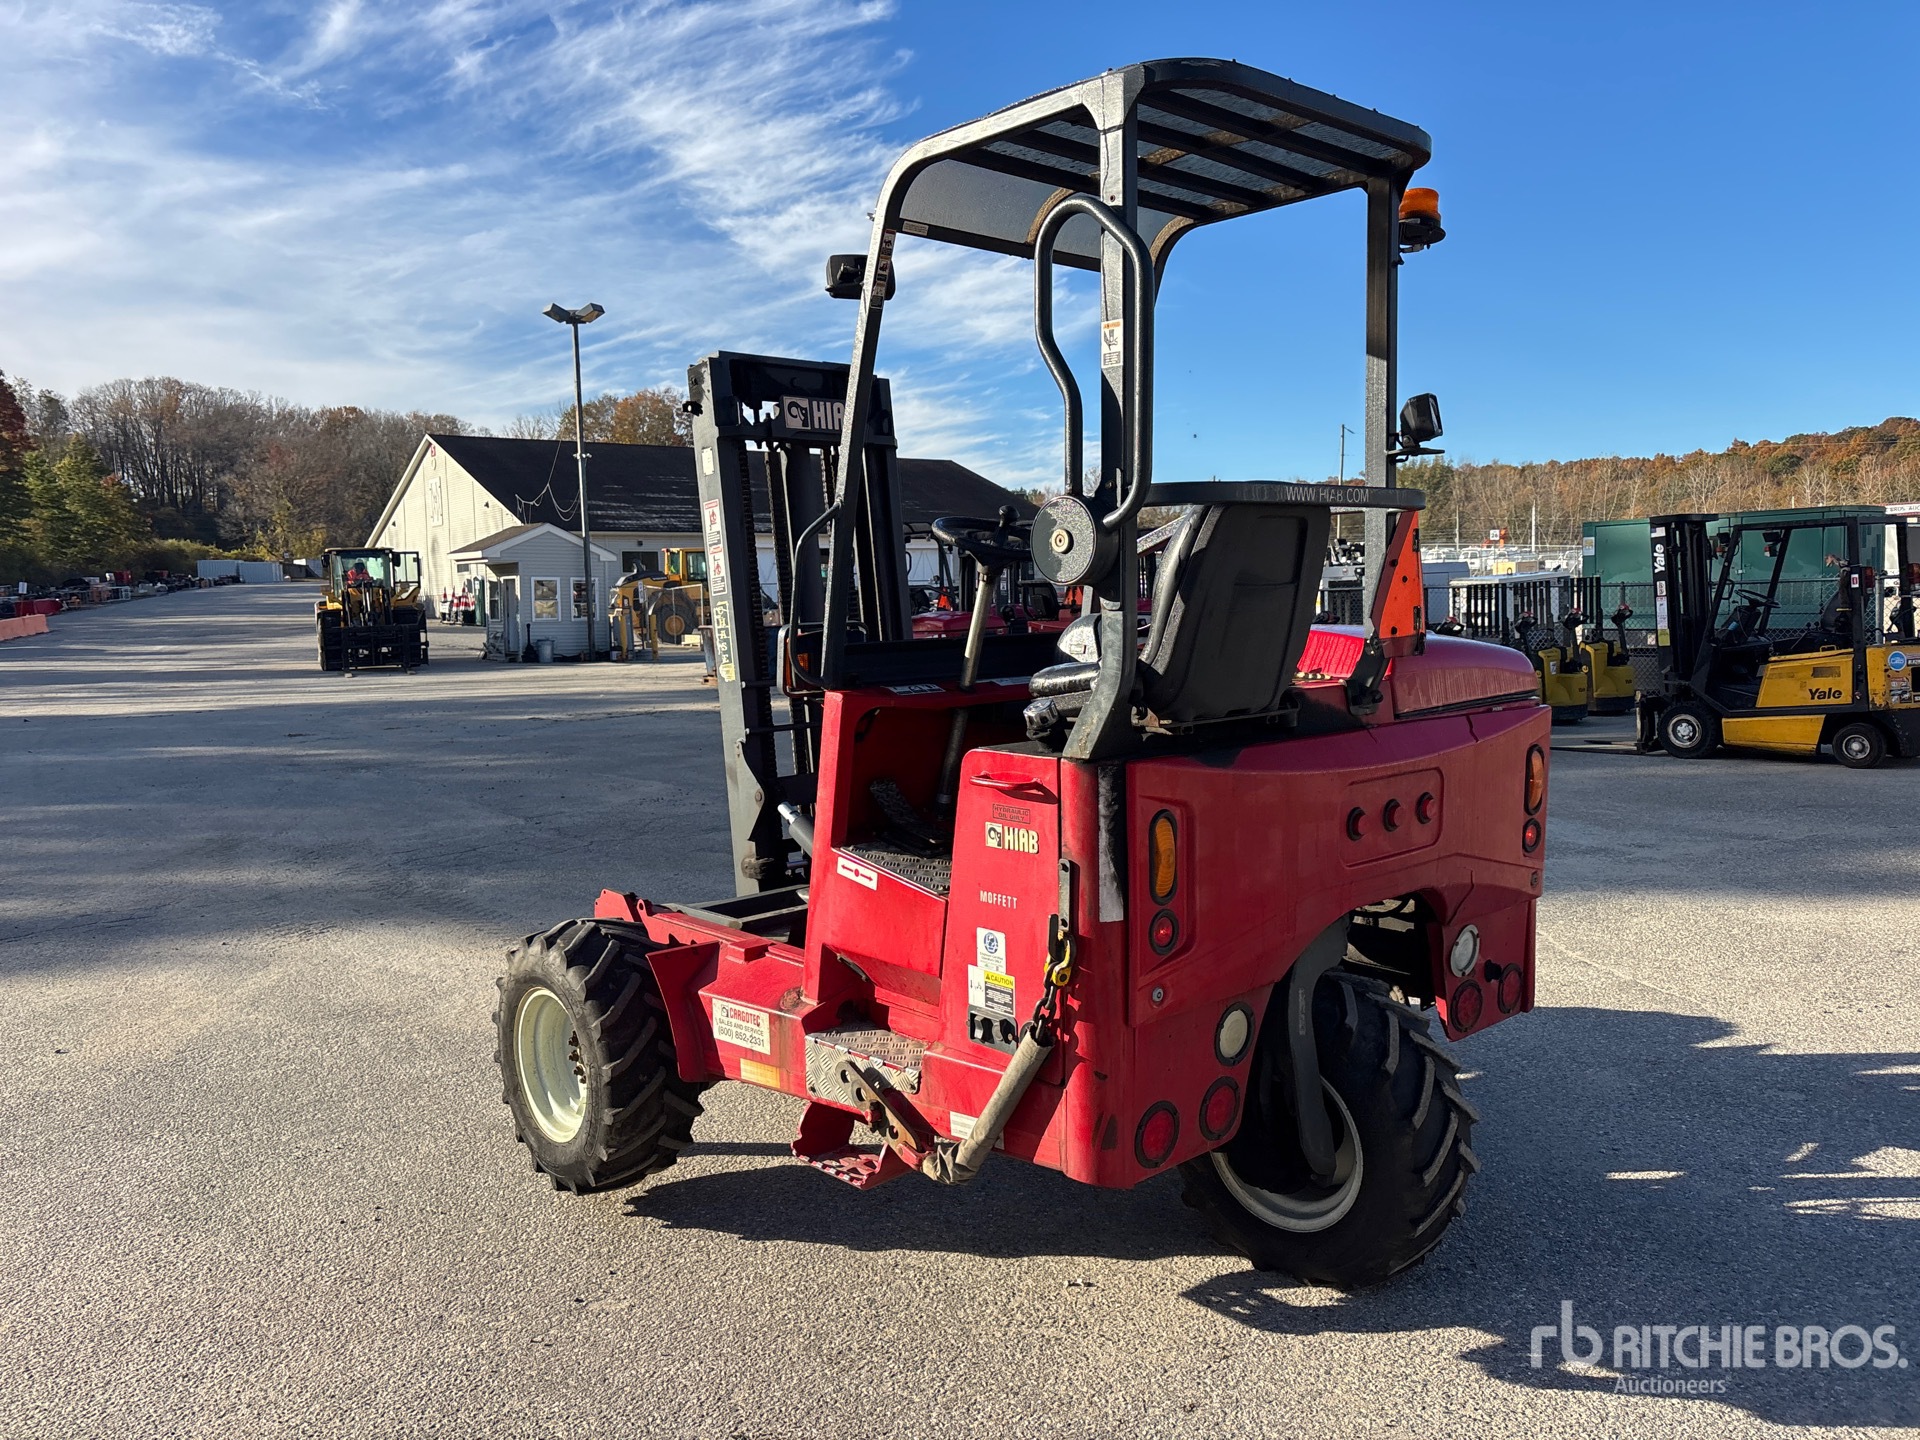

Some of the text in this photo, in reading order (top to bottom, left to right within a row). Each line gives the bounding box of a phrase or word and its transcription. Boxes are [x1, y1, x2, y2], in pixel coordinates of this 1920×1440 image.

[812, 401, 845, 430] HIA
[1653, 543, 1666, 574] Yale
[1808, 687, 1843, 700] Yale
[994, 806, 1029, 816] HYDRAULIC
[1009, 813, 1025, 821] ONLY
[1004, 825, 1039, 854] HIAB
[979, 890, 1018, 909] MOFFETT
[990, 974, 1014, 987] CAUTION
[729, 1007, 761, 1027] CARGOTEC
[718, 1017, 764, 1037] SALES AND SERVICE
[718, 1025, 734, 1040] (800)
